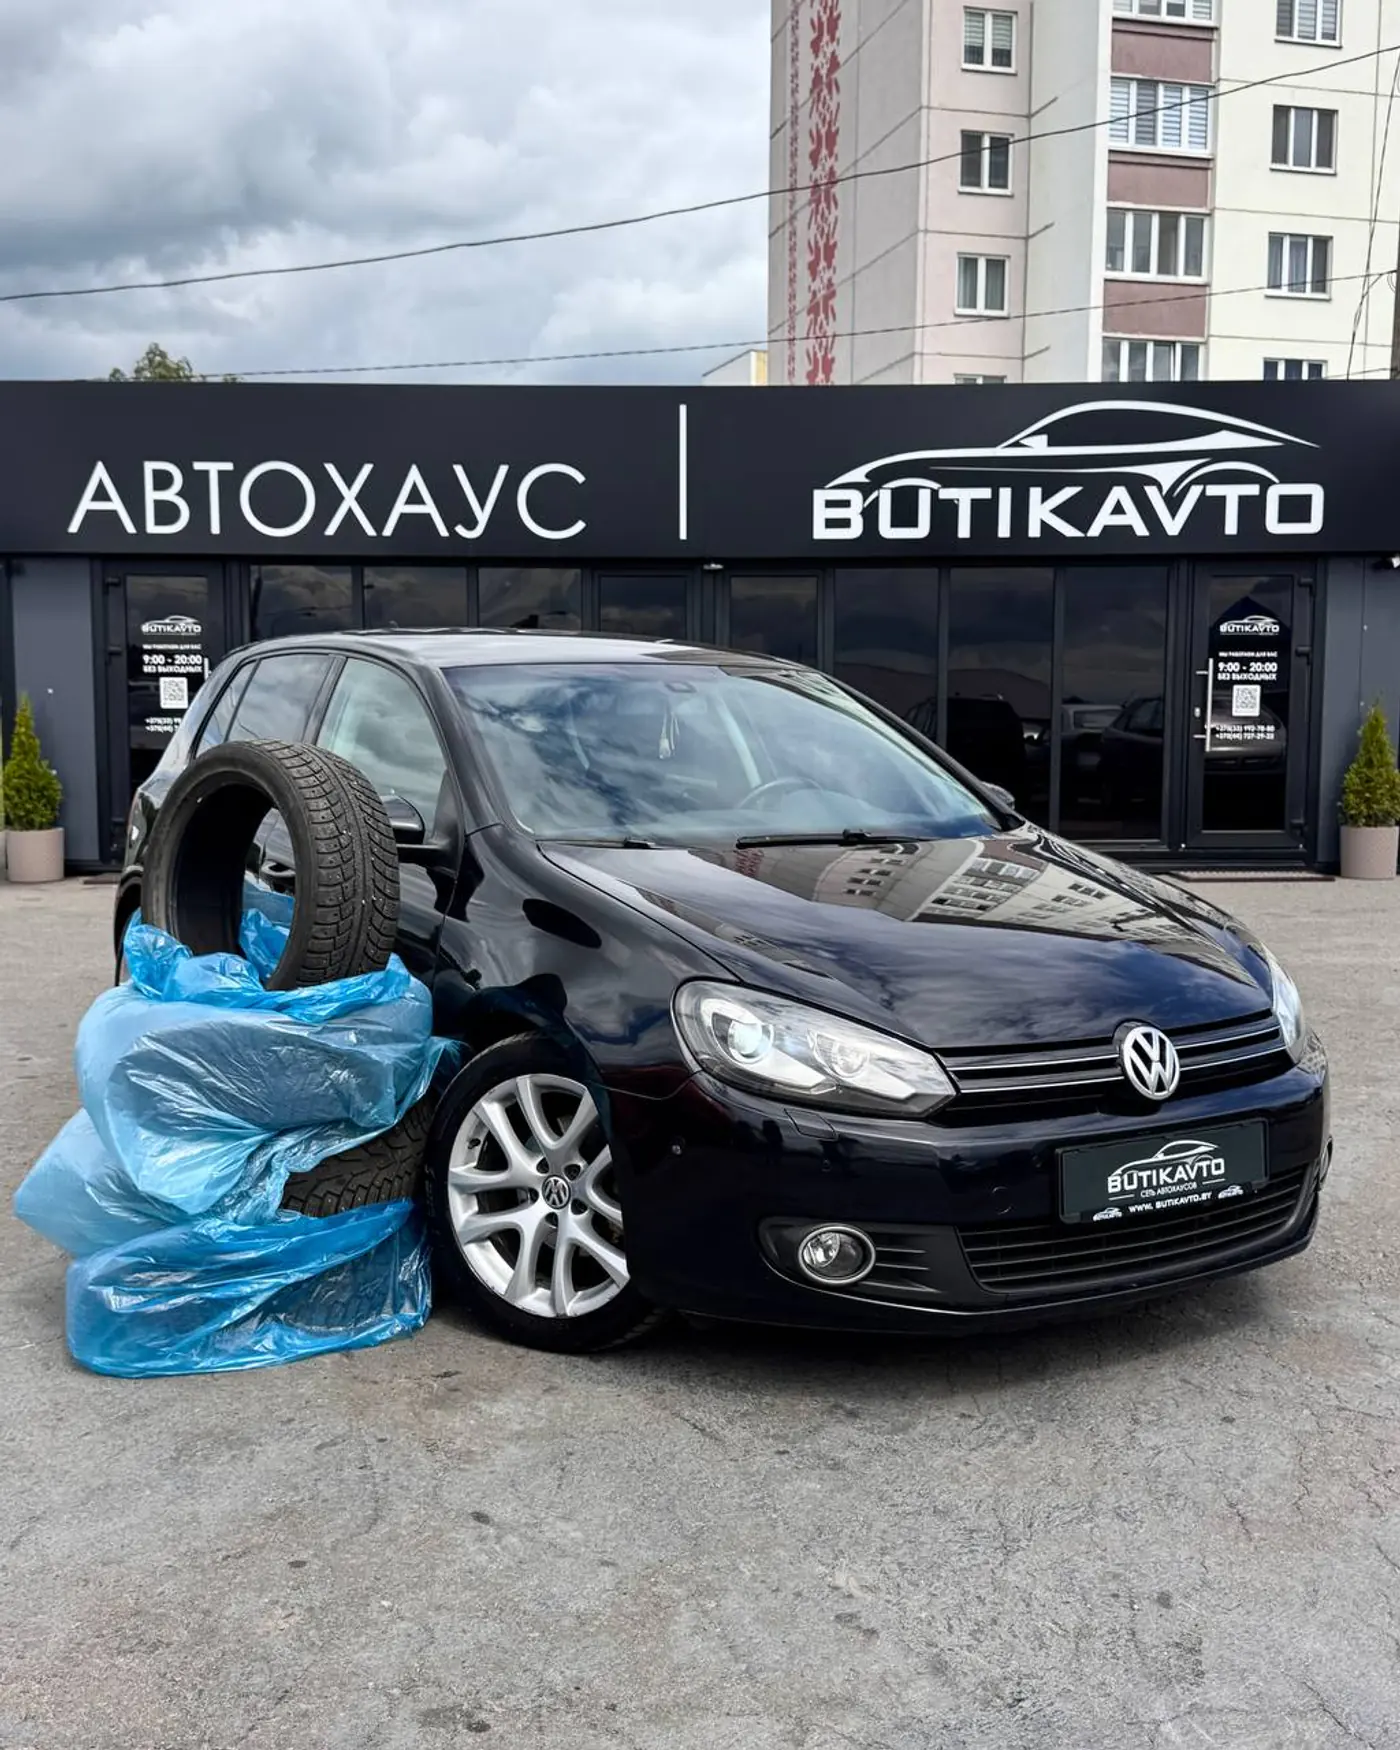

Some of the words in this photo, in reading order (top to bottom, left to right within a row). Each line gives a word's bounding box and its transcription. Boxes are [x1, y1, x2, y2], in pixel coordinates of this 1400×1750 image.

[67, 460, 587, 540] АВТОХАУС
[812, 482, 1325, 541] BUTIKAVTO
[1219, 624, 1280, 633] BUTIKAVTO
[142, 654, 165, 665] 9:00
[173, 654, 202, 665] 20:00
[157, 665, 203, 673] ВЫХОДНЫХ
[1218, 662, 1240, 672] 9:00
[1249, 662, 1278, 672] 20:00
[1231, 673, 1277, 681] ВЫХОДНЫХ
[1107, 1158, 1225, 1193] BUTIKAVTO
[1155, 1192, 1213, 1209] BUTIKAVTO.BY
